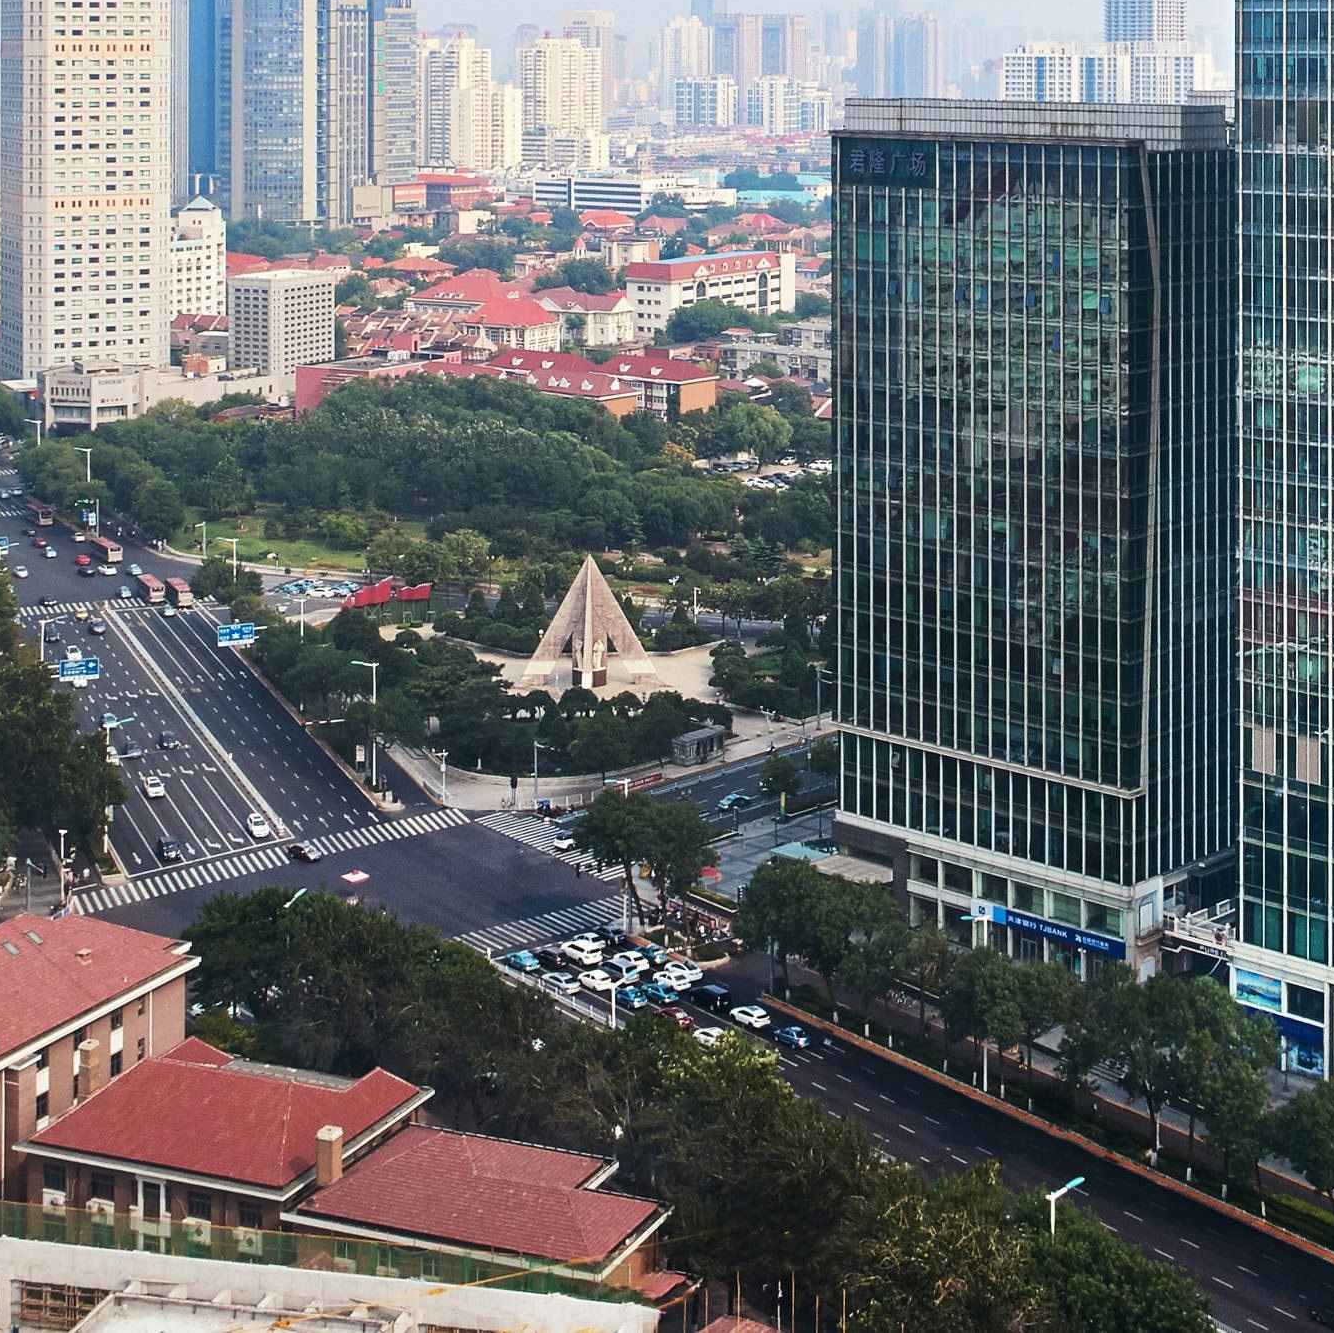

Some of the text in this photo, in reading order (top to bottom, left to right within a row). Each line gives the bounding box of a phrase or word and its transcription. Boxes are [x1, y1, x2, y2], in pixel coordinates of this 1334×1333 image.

[849, 148, 927, 176] 君隆广场
[1039, 923, 1068, 938] TJBANK
